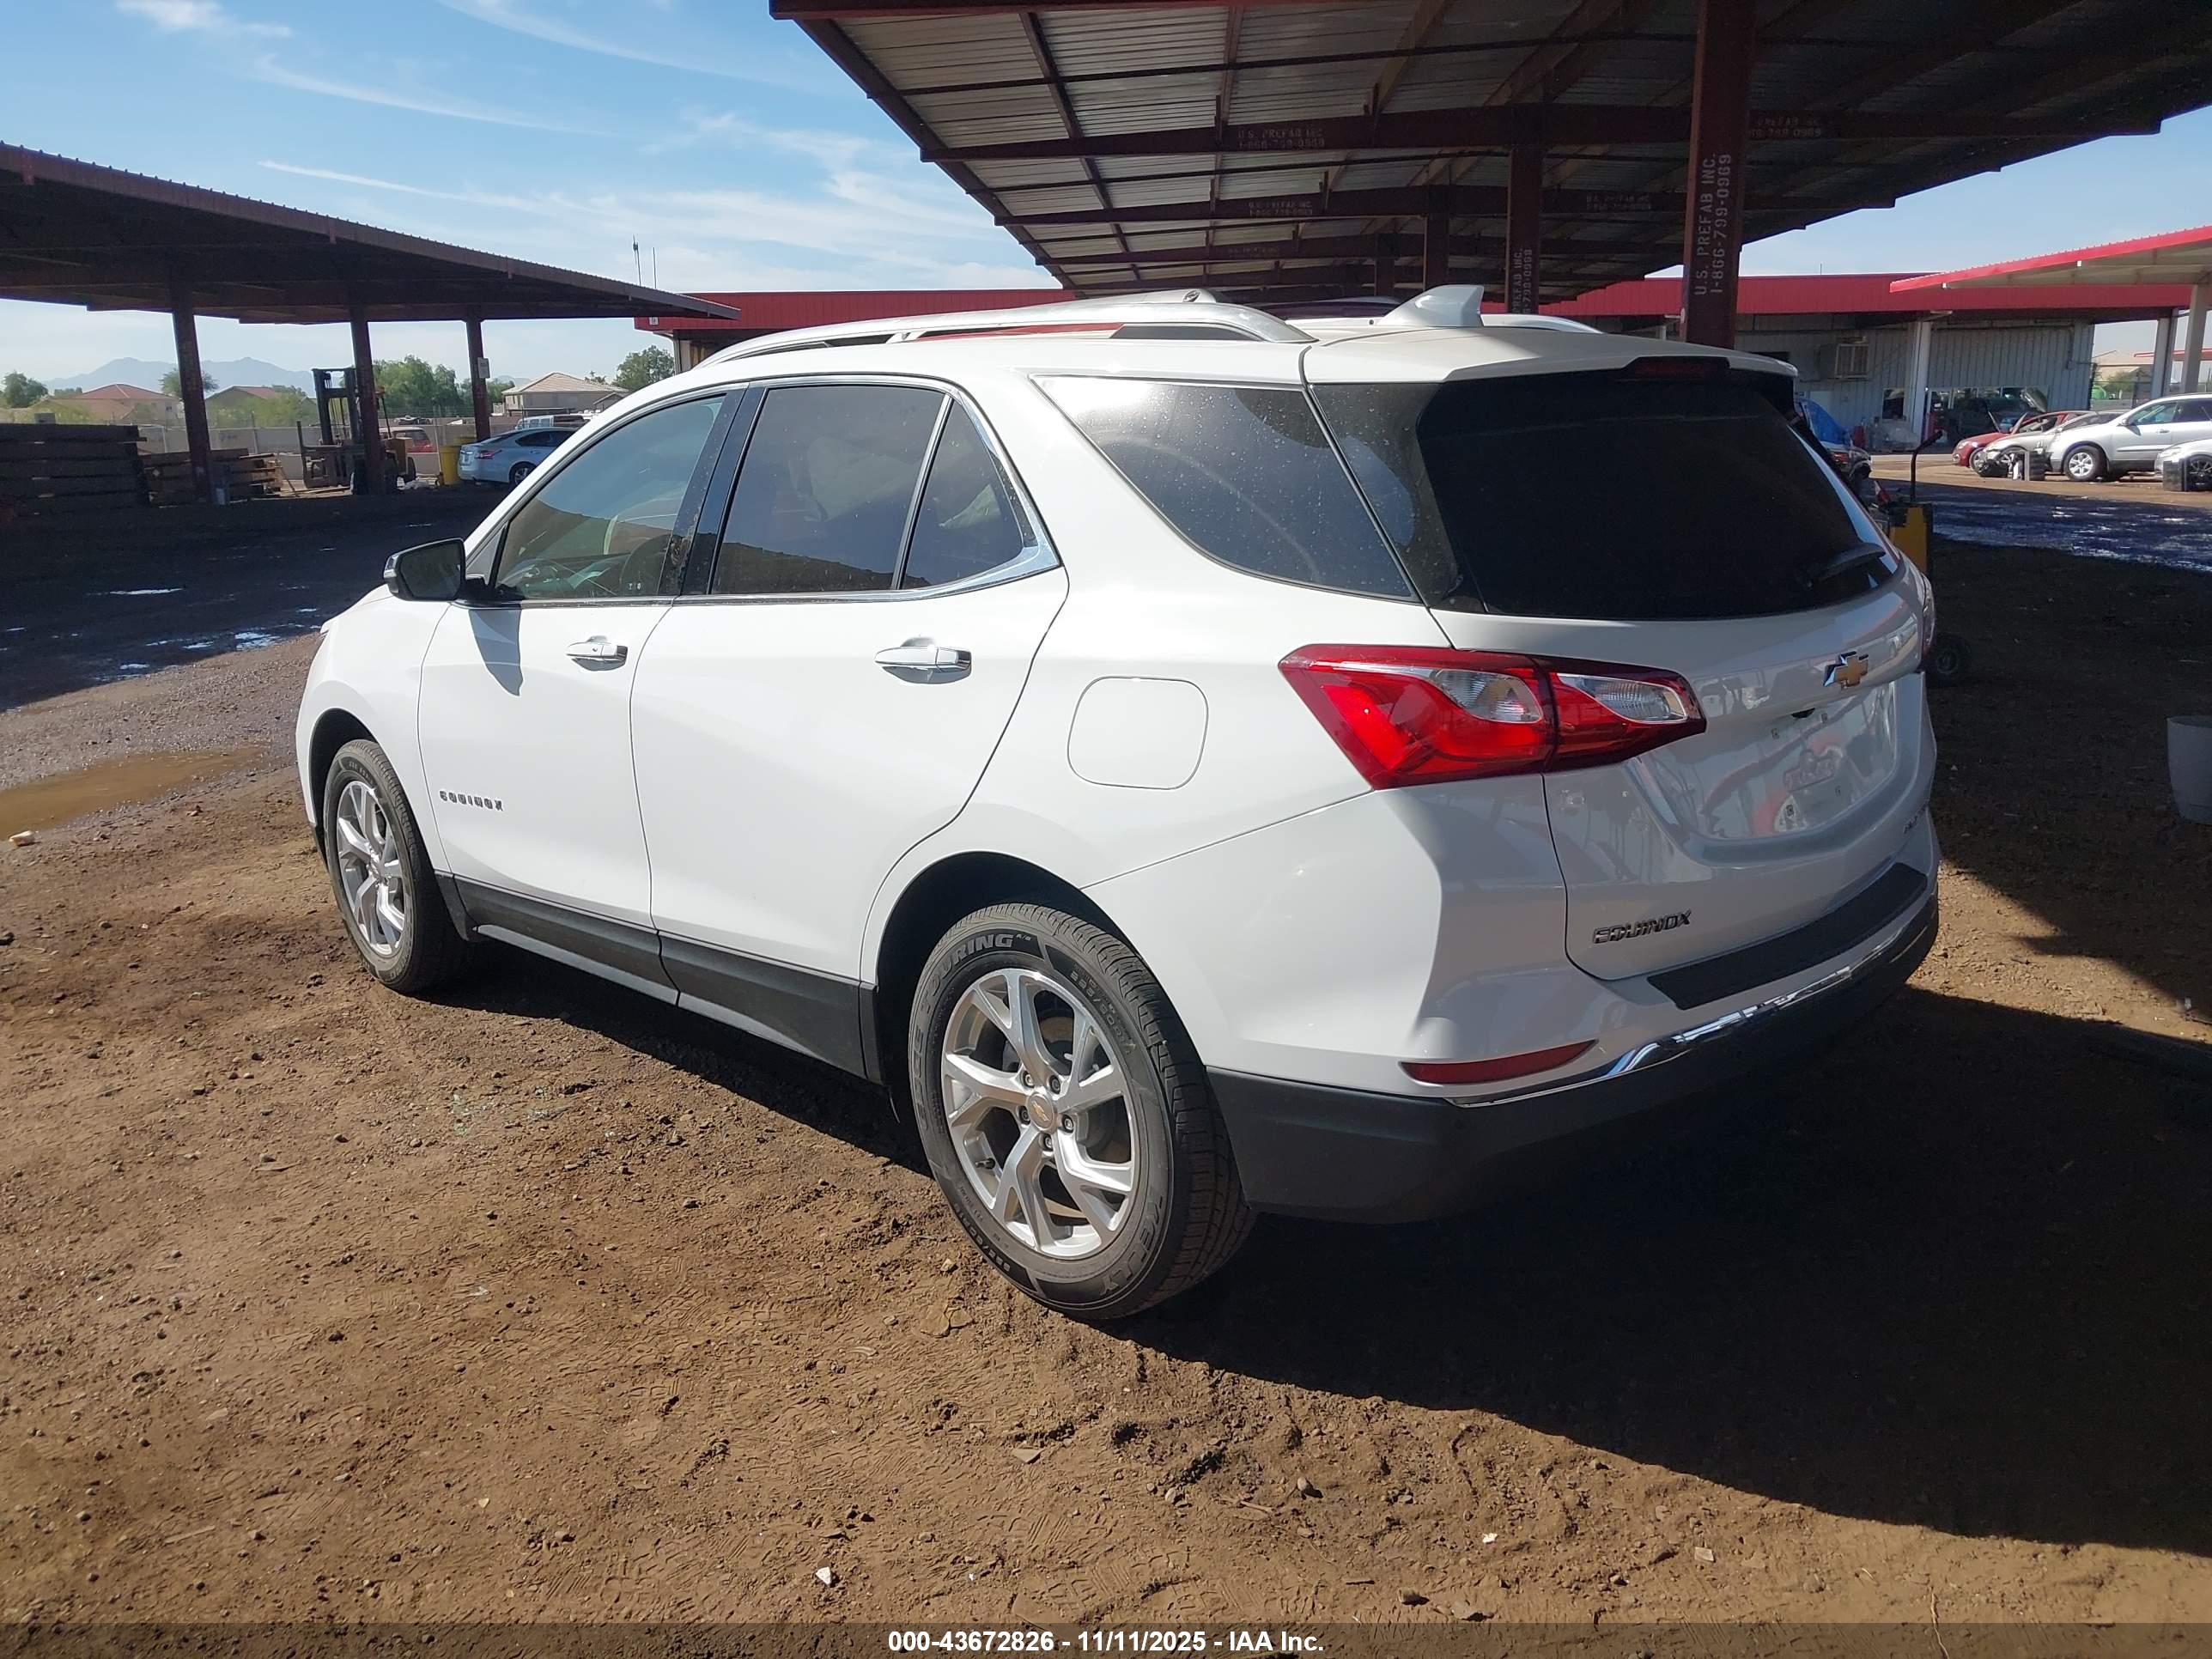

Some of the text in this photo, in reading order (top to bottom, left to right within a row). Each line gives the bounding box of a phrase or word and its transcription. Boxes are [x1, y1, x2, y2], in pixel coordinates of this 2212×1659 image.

[1693, 153, 1717, 295] U.S. PREFAB INC.
[1710, 154, 1732, 294] 1-866-799-0969
[439, 790, 503, 811] EQUINOX
[1593, 908, 1692, 944] EQUINOX
[921, 933, 1014, 1014] TOURING
[1099, 1196, 1164, 1297] KELLY
